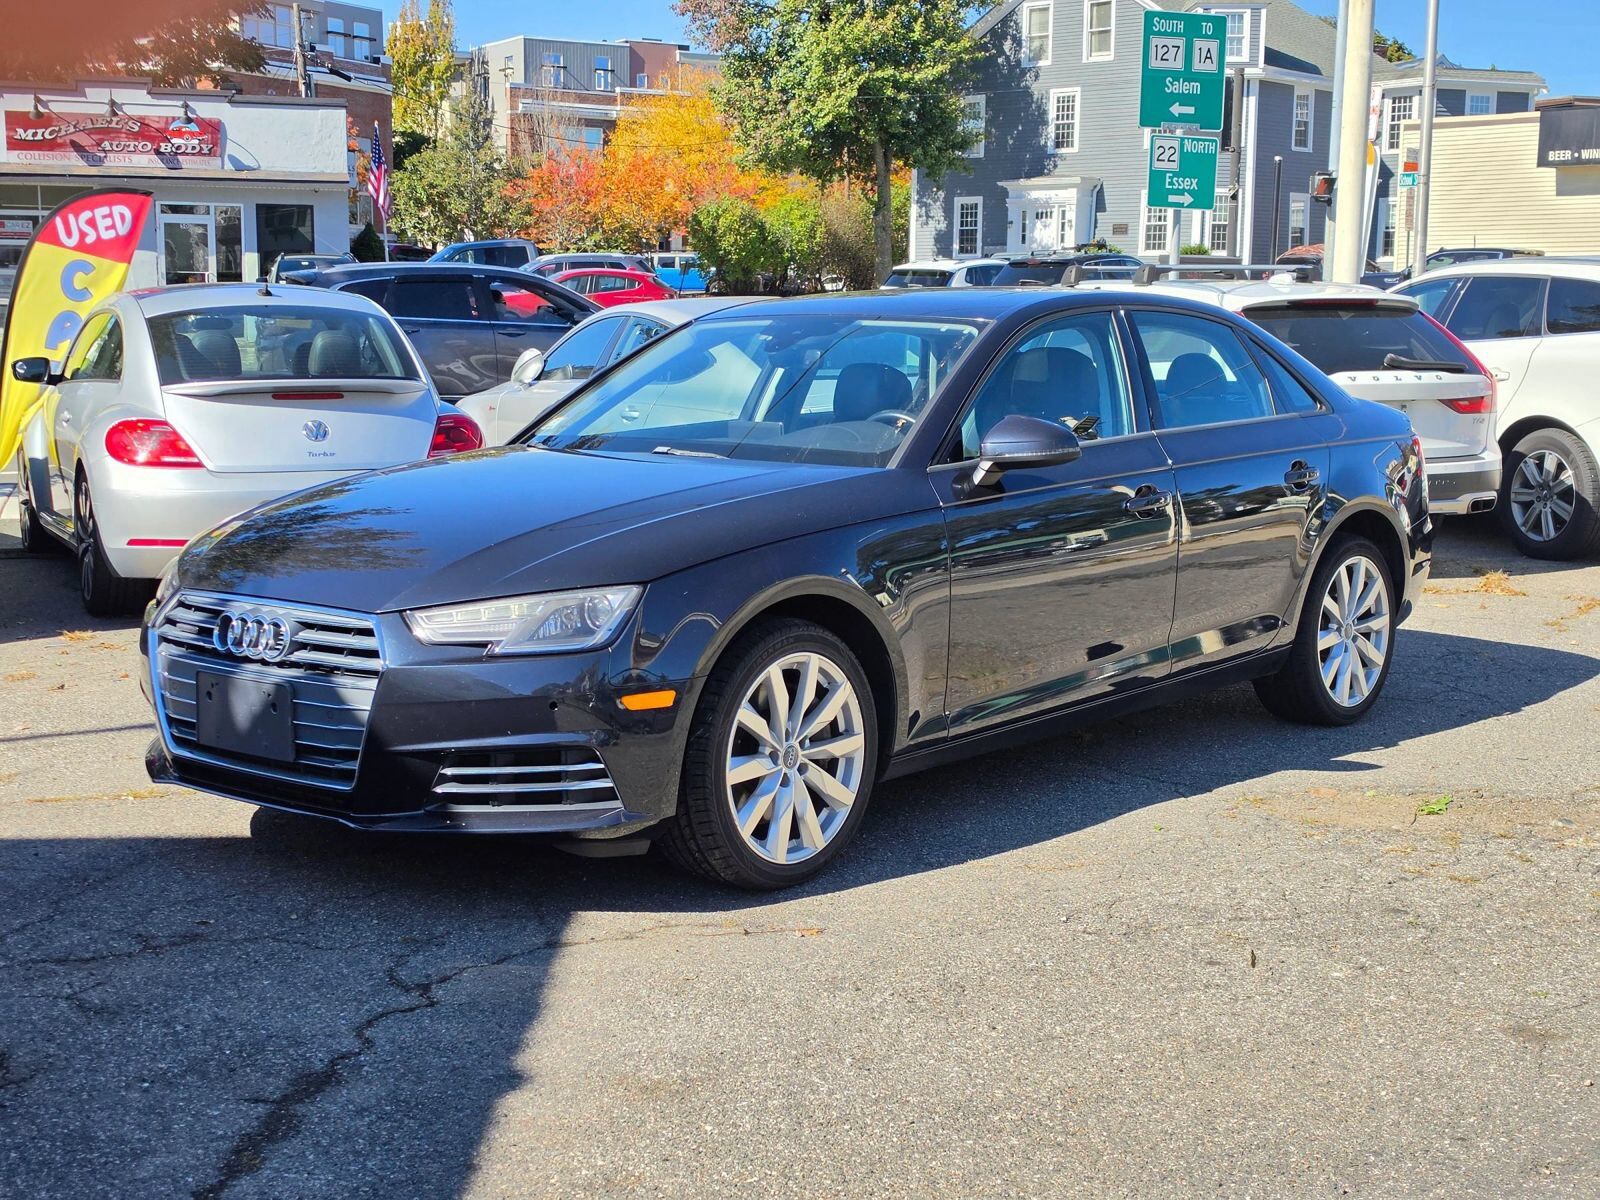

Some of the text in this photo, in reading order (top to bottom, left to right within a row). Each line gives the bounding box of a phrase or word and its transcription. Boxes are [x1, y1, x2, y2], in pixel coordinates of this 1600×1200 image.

[1152, 16, 1213, 35] SOUTH TO
[1154, 44, 1214, 64] 127 1A
[1165, 77, 1201, 95] Salem
[13, 117, 141, 141] MICHAEL'S
[98, 140, 213, 154] AUTO BODY
[1156, 139, 1216, 163] 22 NORTH
[1548, 149, 1572, 161] BEER
[17, 152, 70, 161] COLLISION
[1165, 173, 1199, 190] Essex
[55, 204, 132, 248] USED
[1347, 374, 1443, 382] VOLVO
